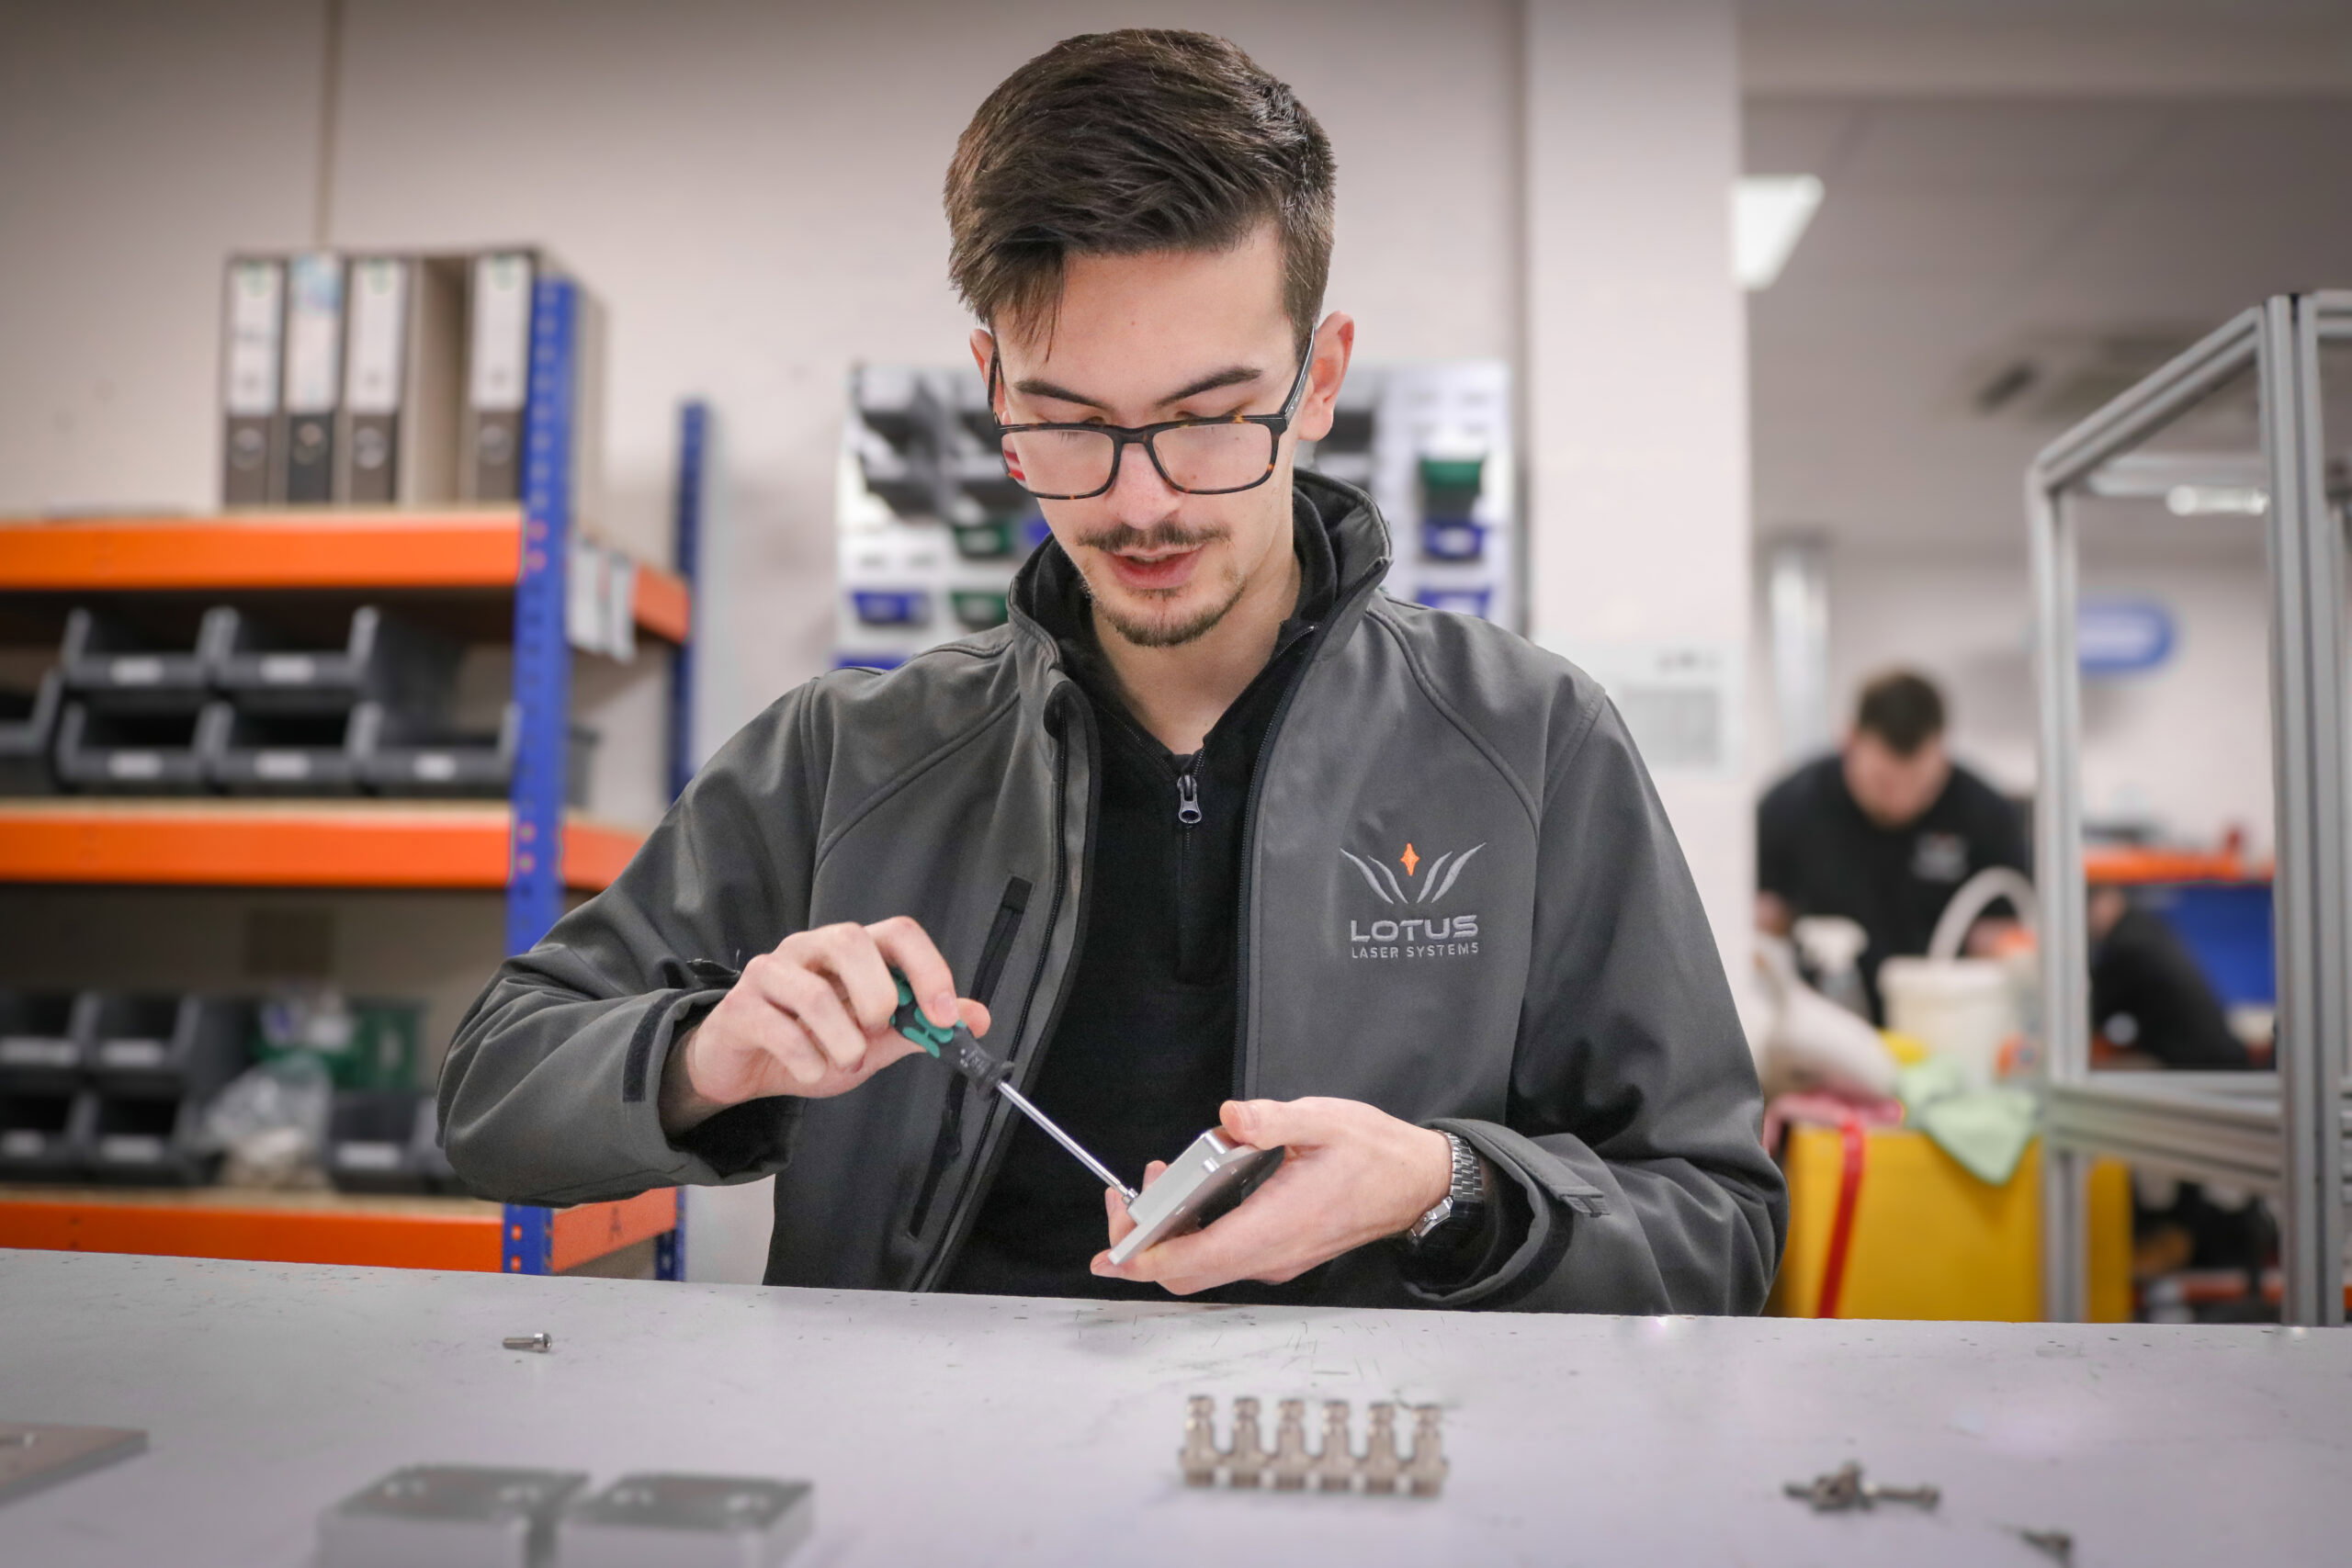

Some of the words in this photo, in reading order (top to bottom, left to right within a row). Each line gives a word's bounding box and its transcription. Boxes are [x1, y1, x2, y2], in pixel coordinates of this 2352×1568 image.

[1351, 915, 1478, 942] LOTUS
[1351, 946, 1399, 959] LASER
[1407, 942, 1478, 958] SYSTEMS
